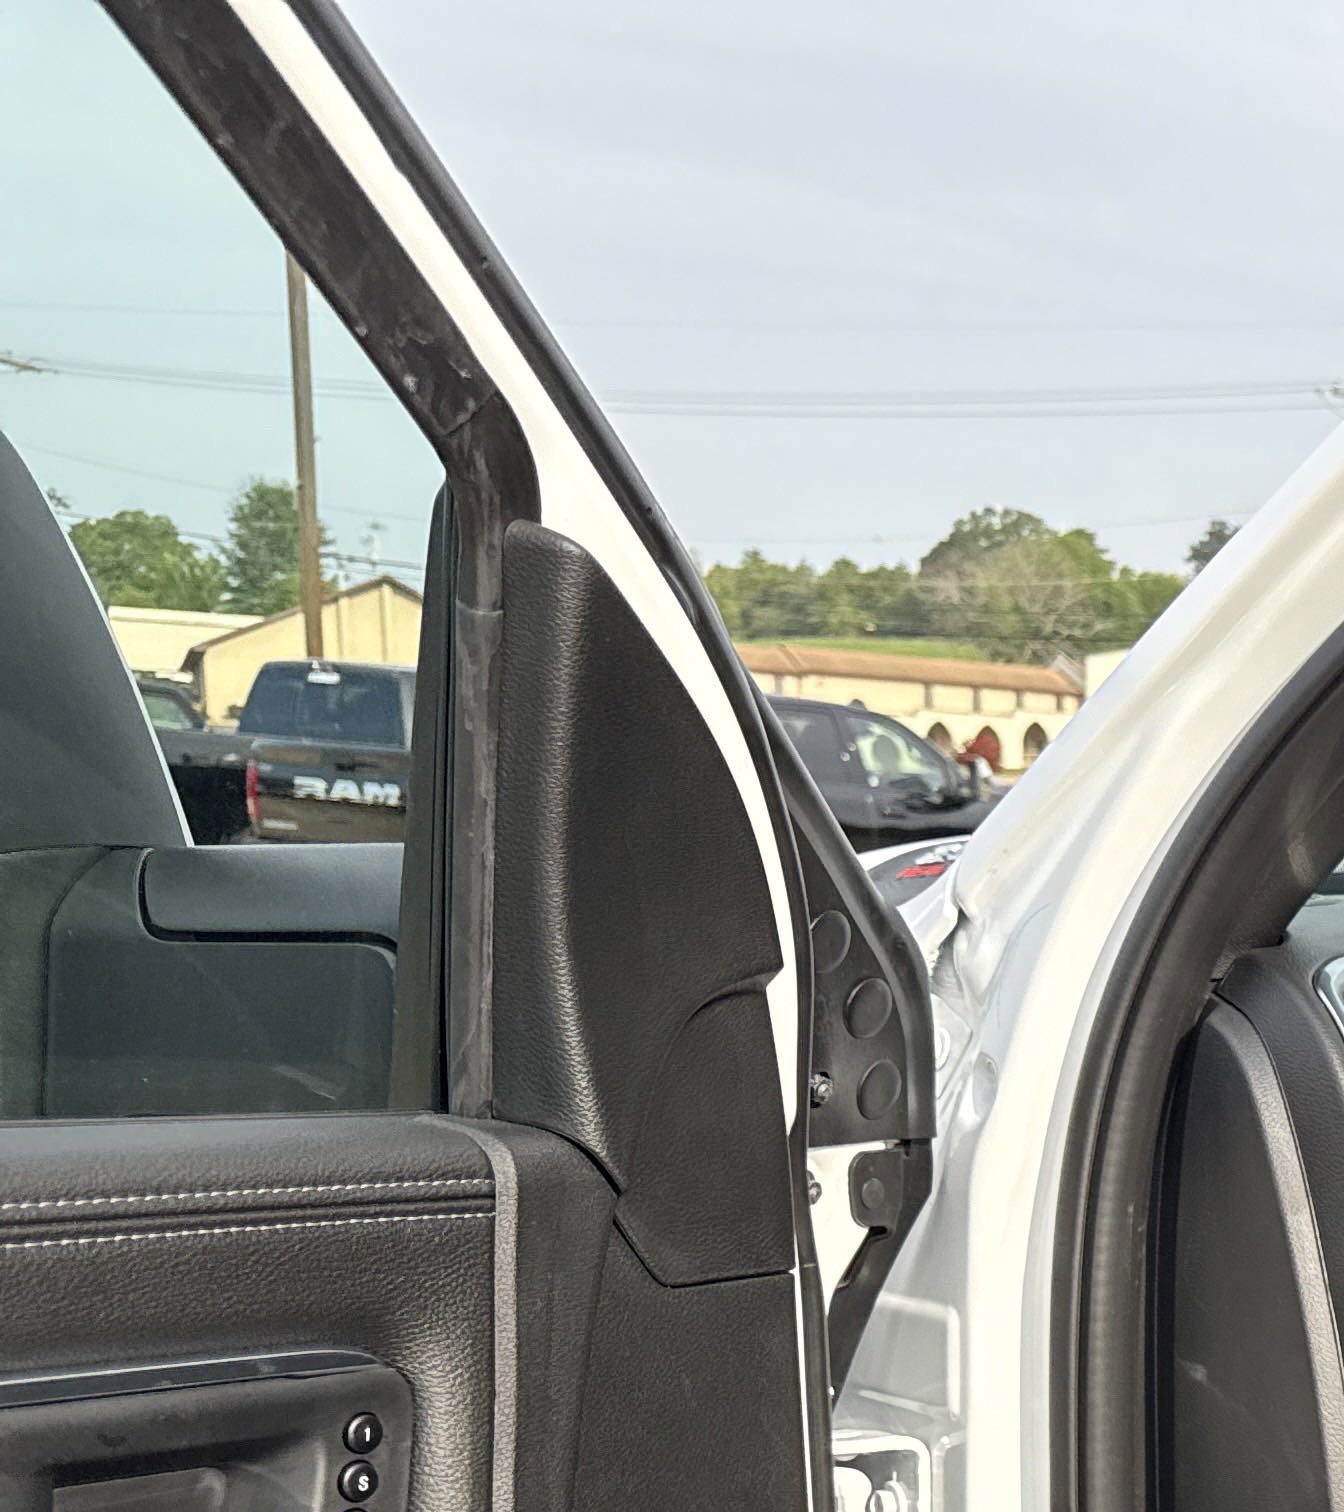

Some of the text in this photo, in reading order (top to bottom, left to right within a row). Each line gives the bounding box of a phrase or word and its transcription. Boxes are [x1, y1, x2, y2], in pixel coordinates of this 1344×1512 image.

[293, 776, 401, 808] RAM
[364, 1427, 371, 1442] 1
[357, 1475, 369, 1492] S
